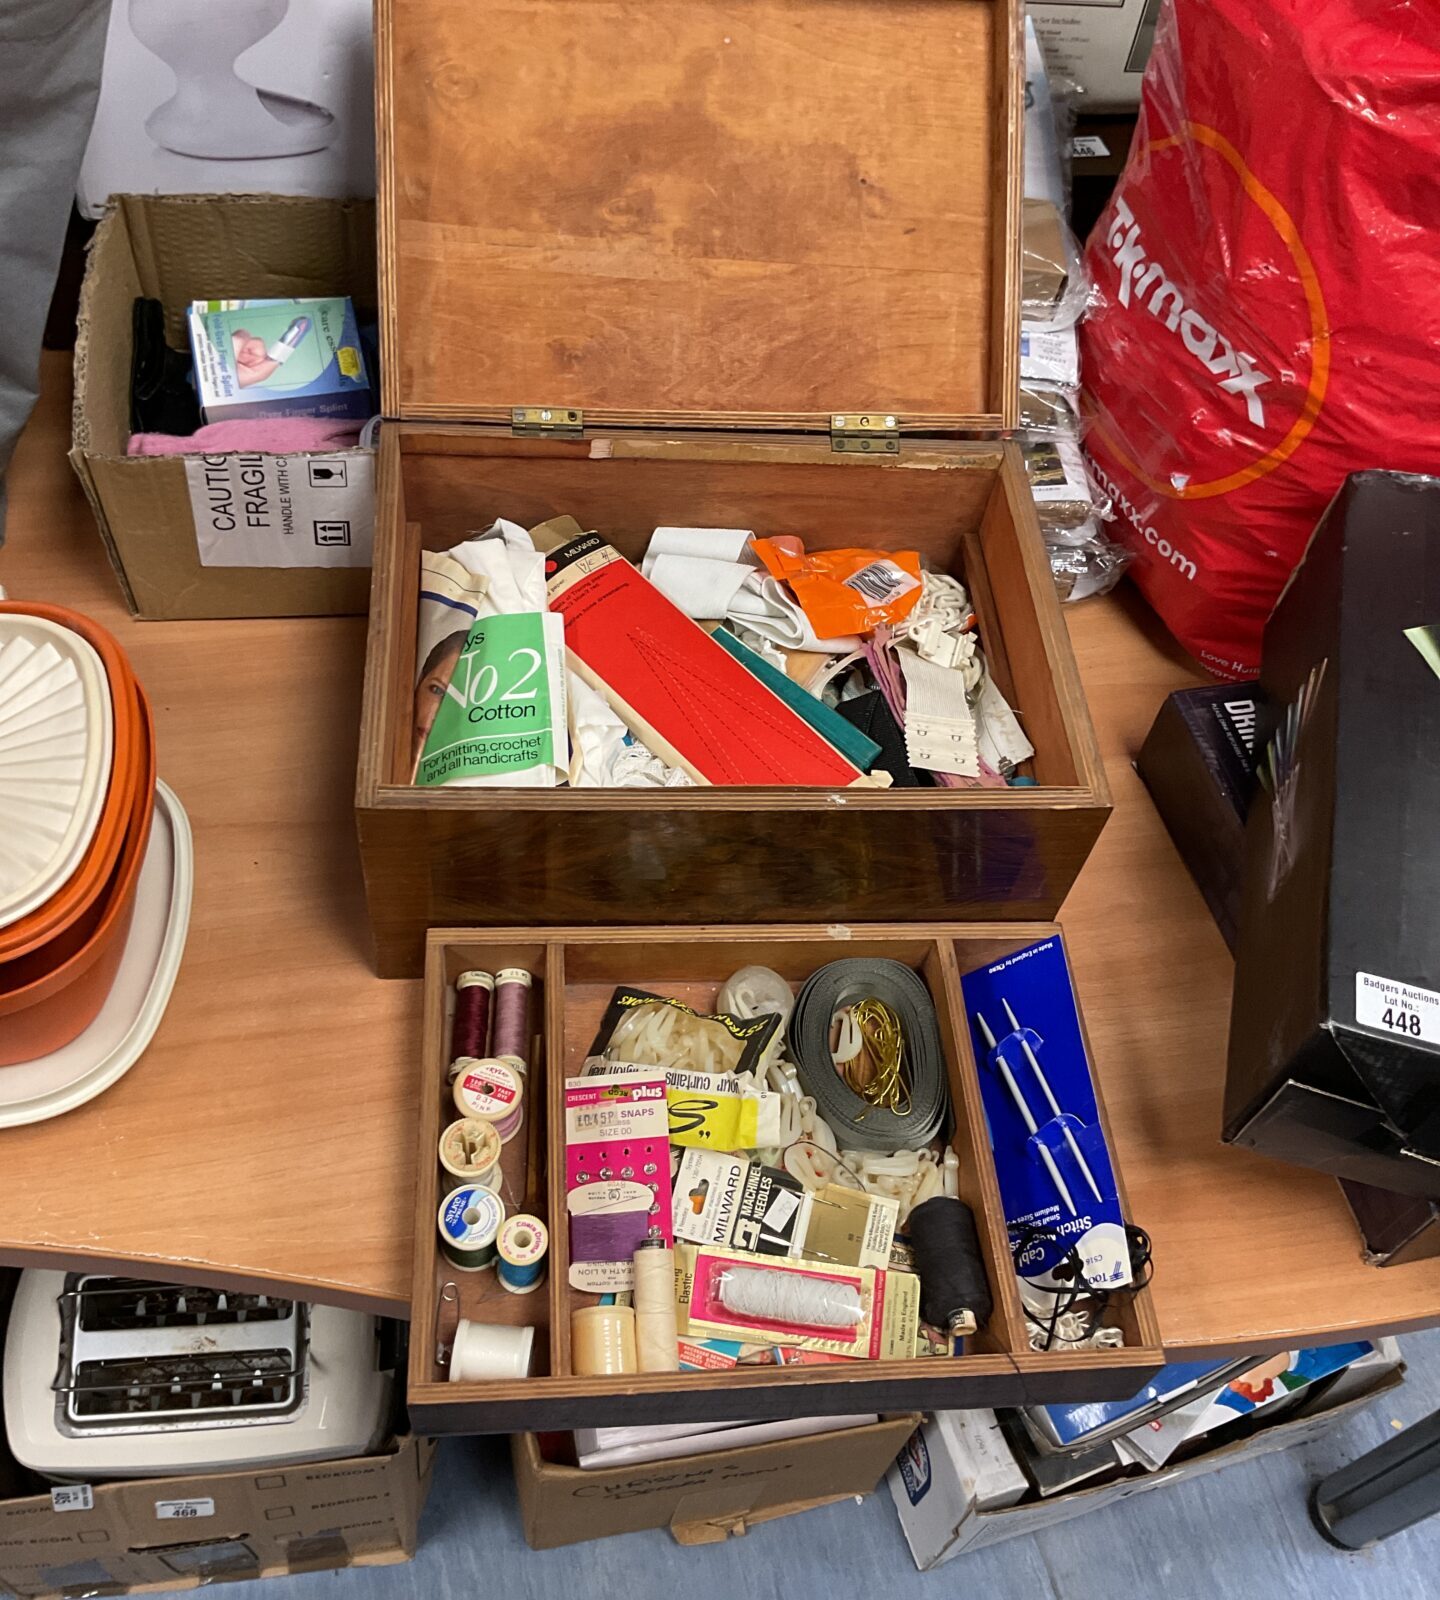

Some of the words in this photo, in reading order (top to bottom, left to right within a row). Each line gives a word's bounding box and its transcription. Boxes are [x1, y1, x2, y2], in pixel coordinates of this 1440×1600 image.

[276, 470, 290, 495] WITH
[280, 496, 294, 535] HANDLE
[564, 538, 600, 558] MILWARD
[499, 648, 541, 701] 2
[468, 703, 536, 723] Cotton
[423, 756, 443, 773] For
[489, 736, 541, 751] crochet
[426, 765, 447, 782] and
[448, 758, 461, 771] all
[463, 750, 538, 766] handicrafts
[1363, 977, 1399, 994] Badgers
[1402, 988, 1439, 1006] Auctions
[1384, 995, 1398, 1006] Lot
[1382, 1008, 1421, 1036] 448
[666, 1072, 710, 1090] curtains
[568, 1093, 597, 1102] CRESCENT
[632, 1086, 663, 1101] plus
[620, 1108, 655, 1118] SNAPS
[599, 1128, 619, 1137] SIZE
[713, 1164, 742, 1243] MILWARD
[753, 1176, 773, 1219] NEEDLES
[1034, 1205, 1060, 1216] Medium
[1042, 1214, 1060, 1224] Small
[1056, 1216, 1092, 1236] Stitch
[679, 1272, 692, 1305] Elastic
[901, 1291, 909, 1316] England
